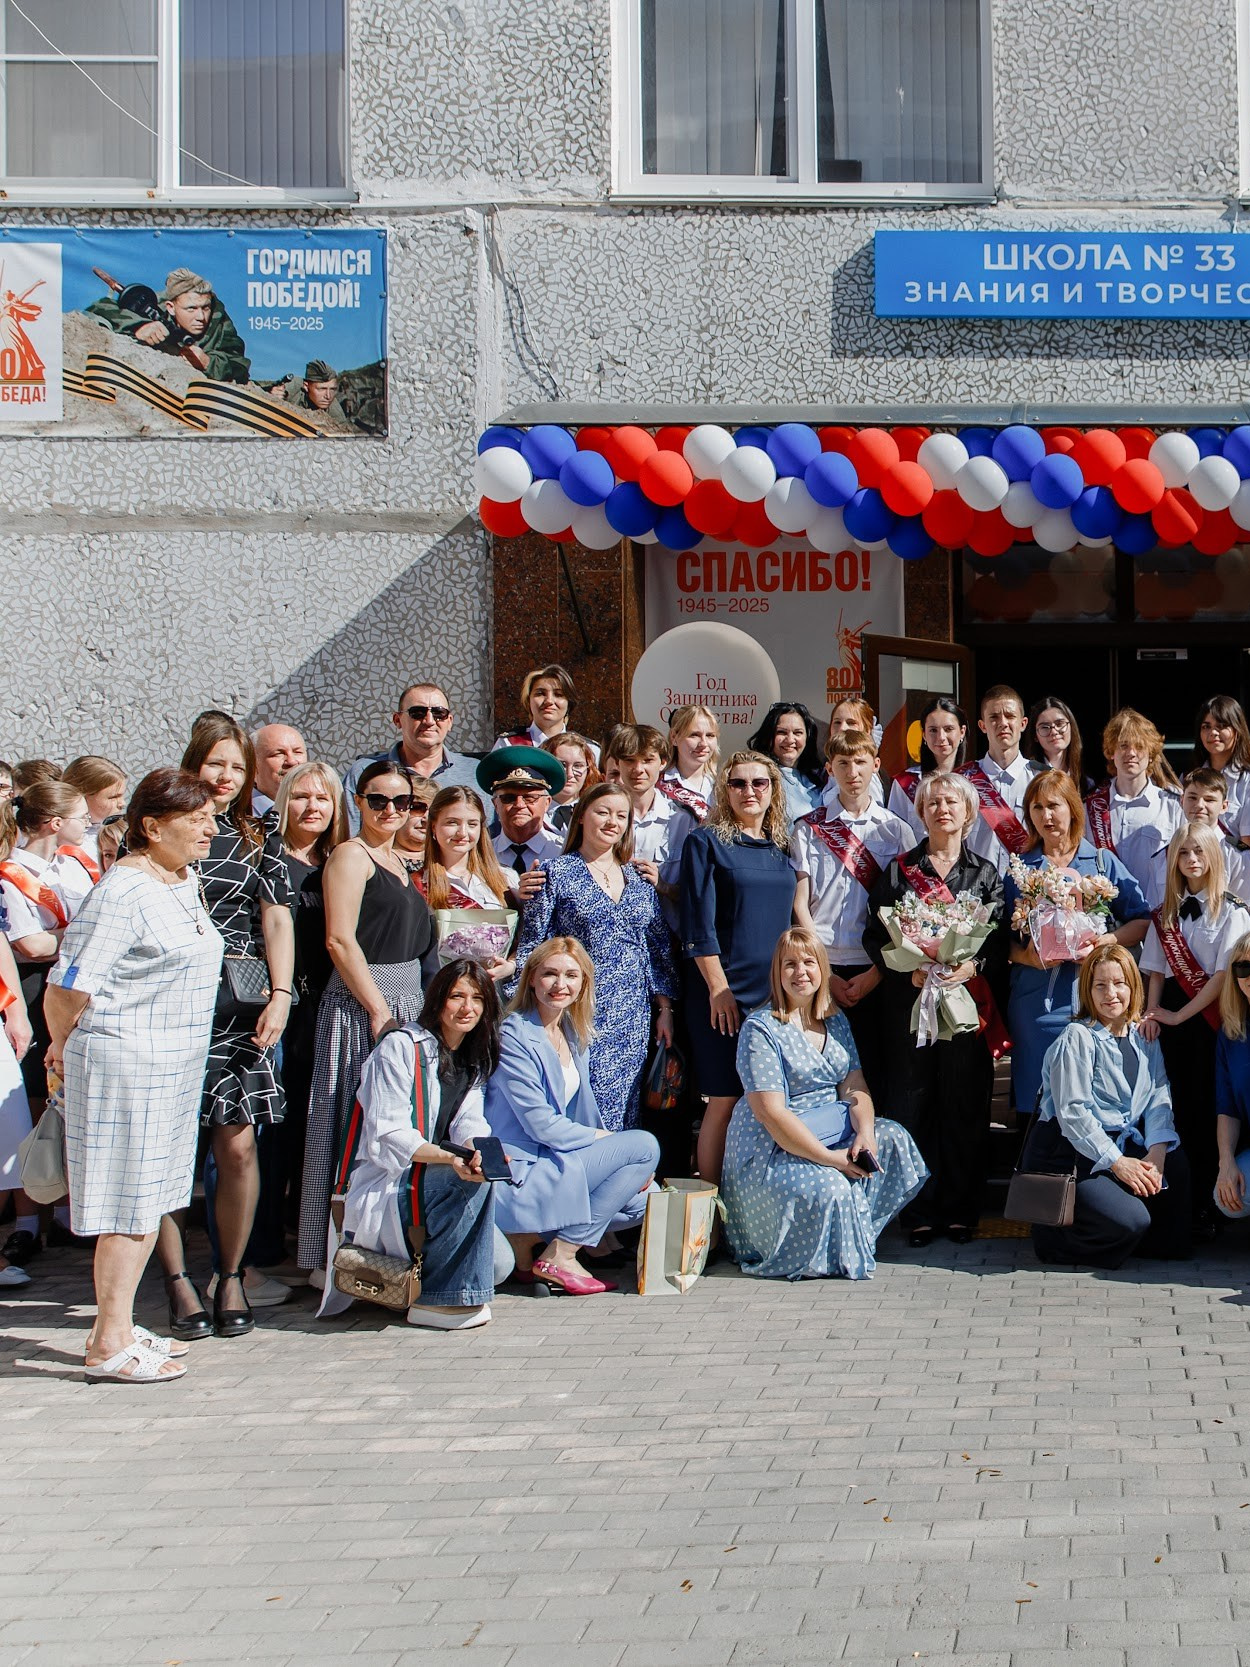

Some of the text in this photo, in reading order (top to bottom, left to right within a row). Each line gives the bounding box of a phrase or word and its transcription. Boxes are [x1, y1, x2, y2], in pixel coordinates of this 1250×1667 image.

[246, 248, 372, 279] ГОРДИМСЯ
[983, 243, 1237, 272] ШКОЛА № 33
[246, 278, 361, 312] ПОБЕДОЙ!
[904, 281, 1050, 304] ЗНАНИЯ
[1062, 282, 1084, 304] И
[0, 348, 16, 380] 0
[1, 386, 46, 405] БЕДА!
[676, 550, 872, 593] СПАСИБО!
[696, 673, 727, 692] Год
[826, 667, 851, 689] 80
[663, 688, 758, 707] Защитника
